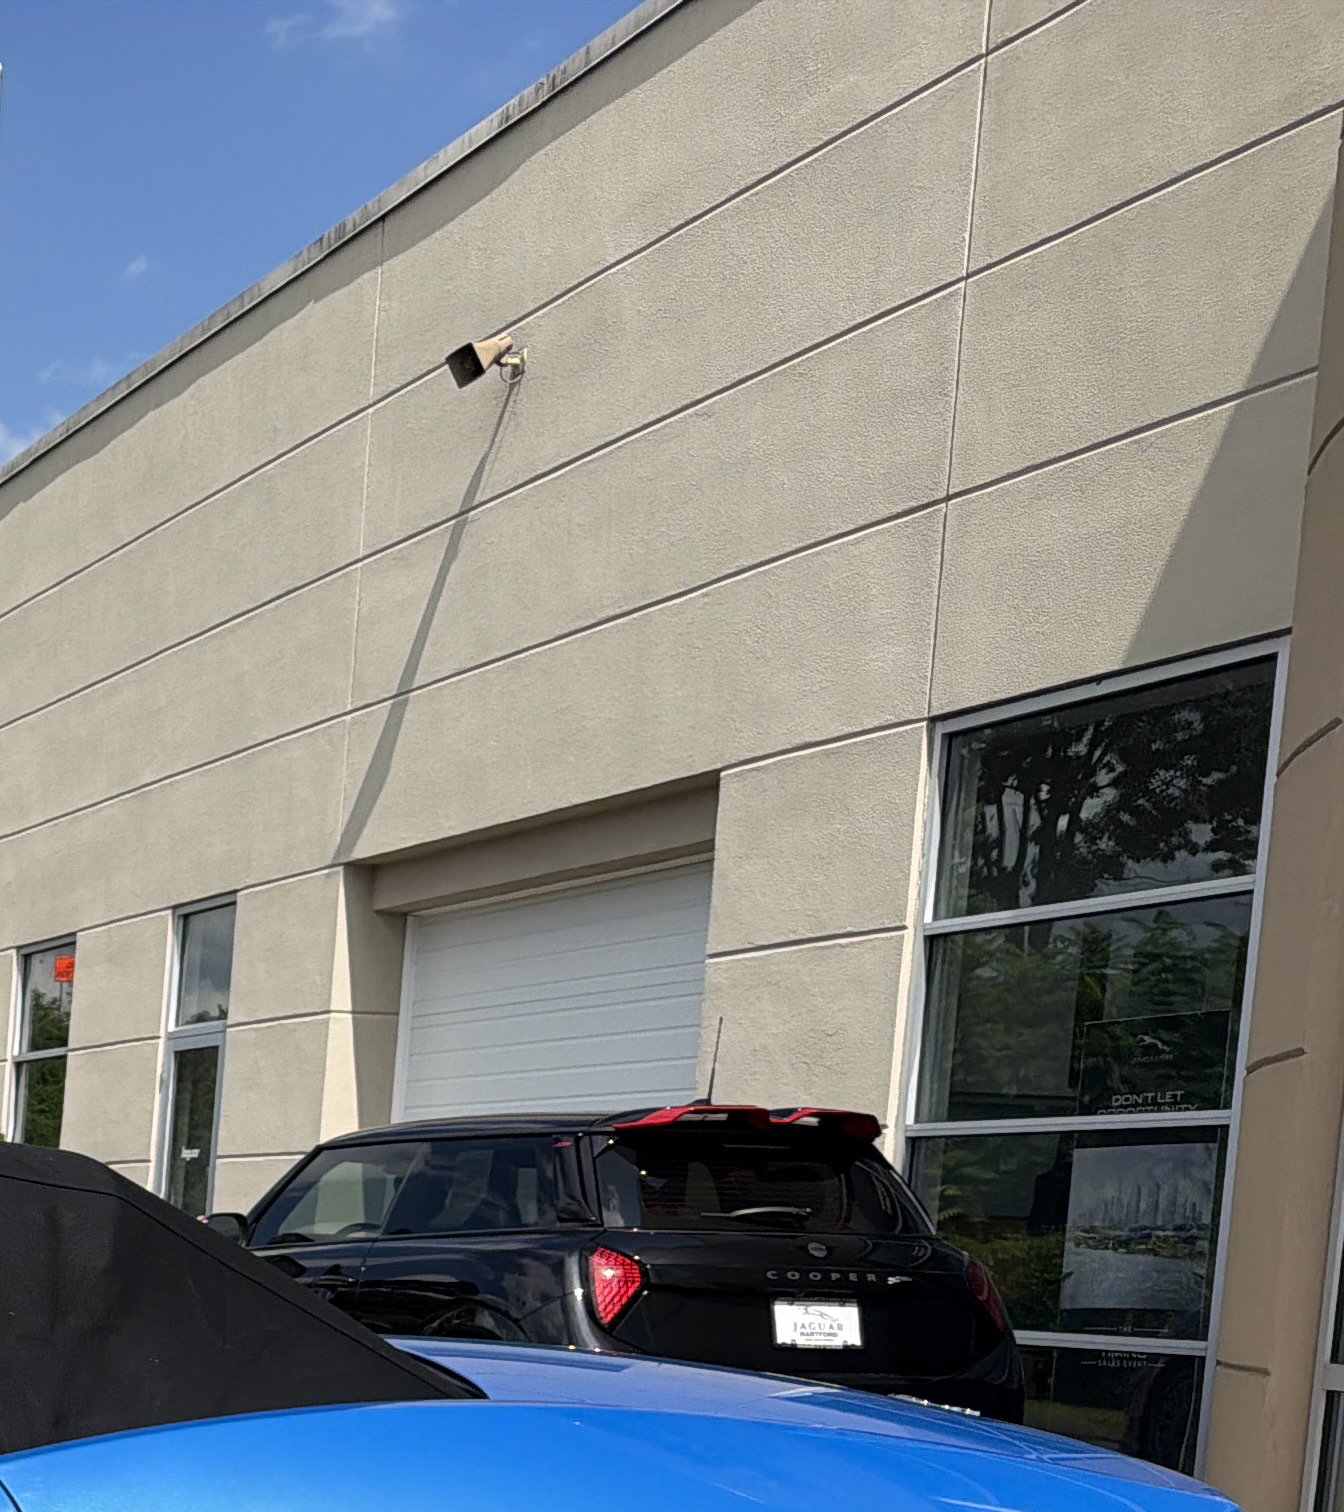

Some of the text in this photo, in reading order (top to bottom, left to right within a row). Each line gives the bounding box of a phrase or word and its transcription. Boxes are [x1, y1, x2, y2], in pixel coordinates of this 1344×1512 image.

[1112, 1090, 1185, 1106] DON'T LET
[766, 1270, 878, 1282] COOPER
[793, 1321, 844, 1333] JAGUAR
